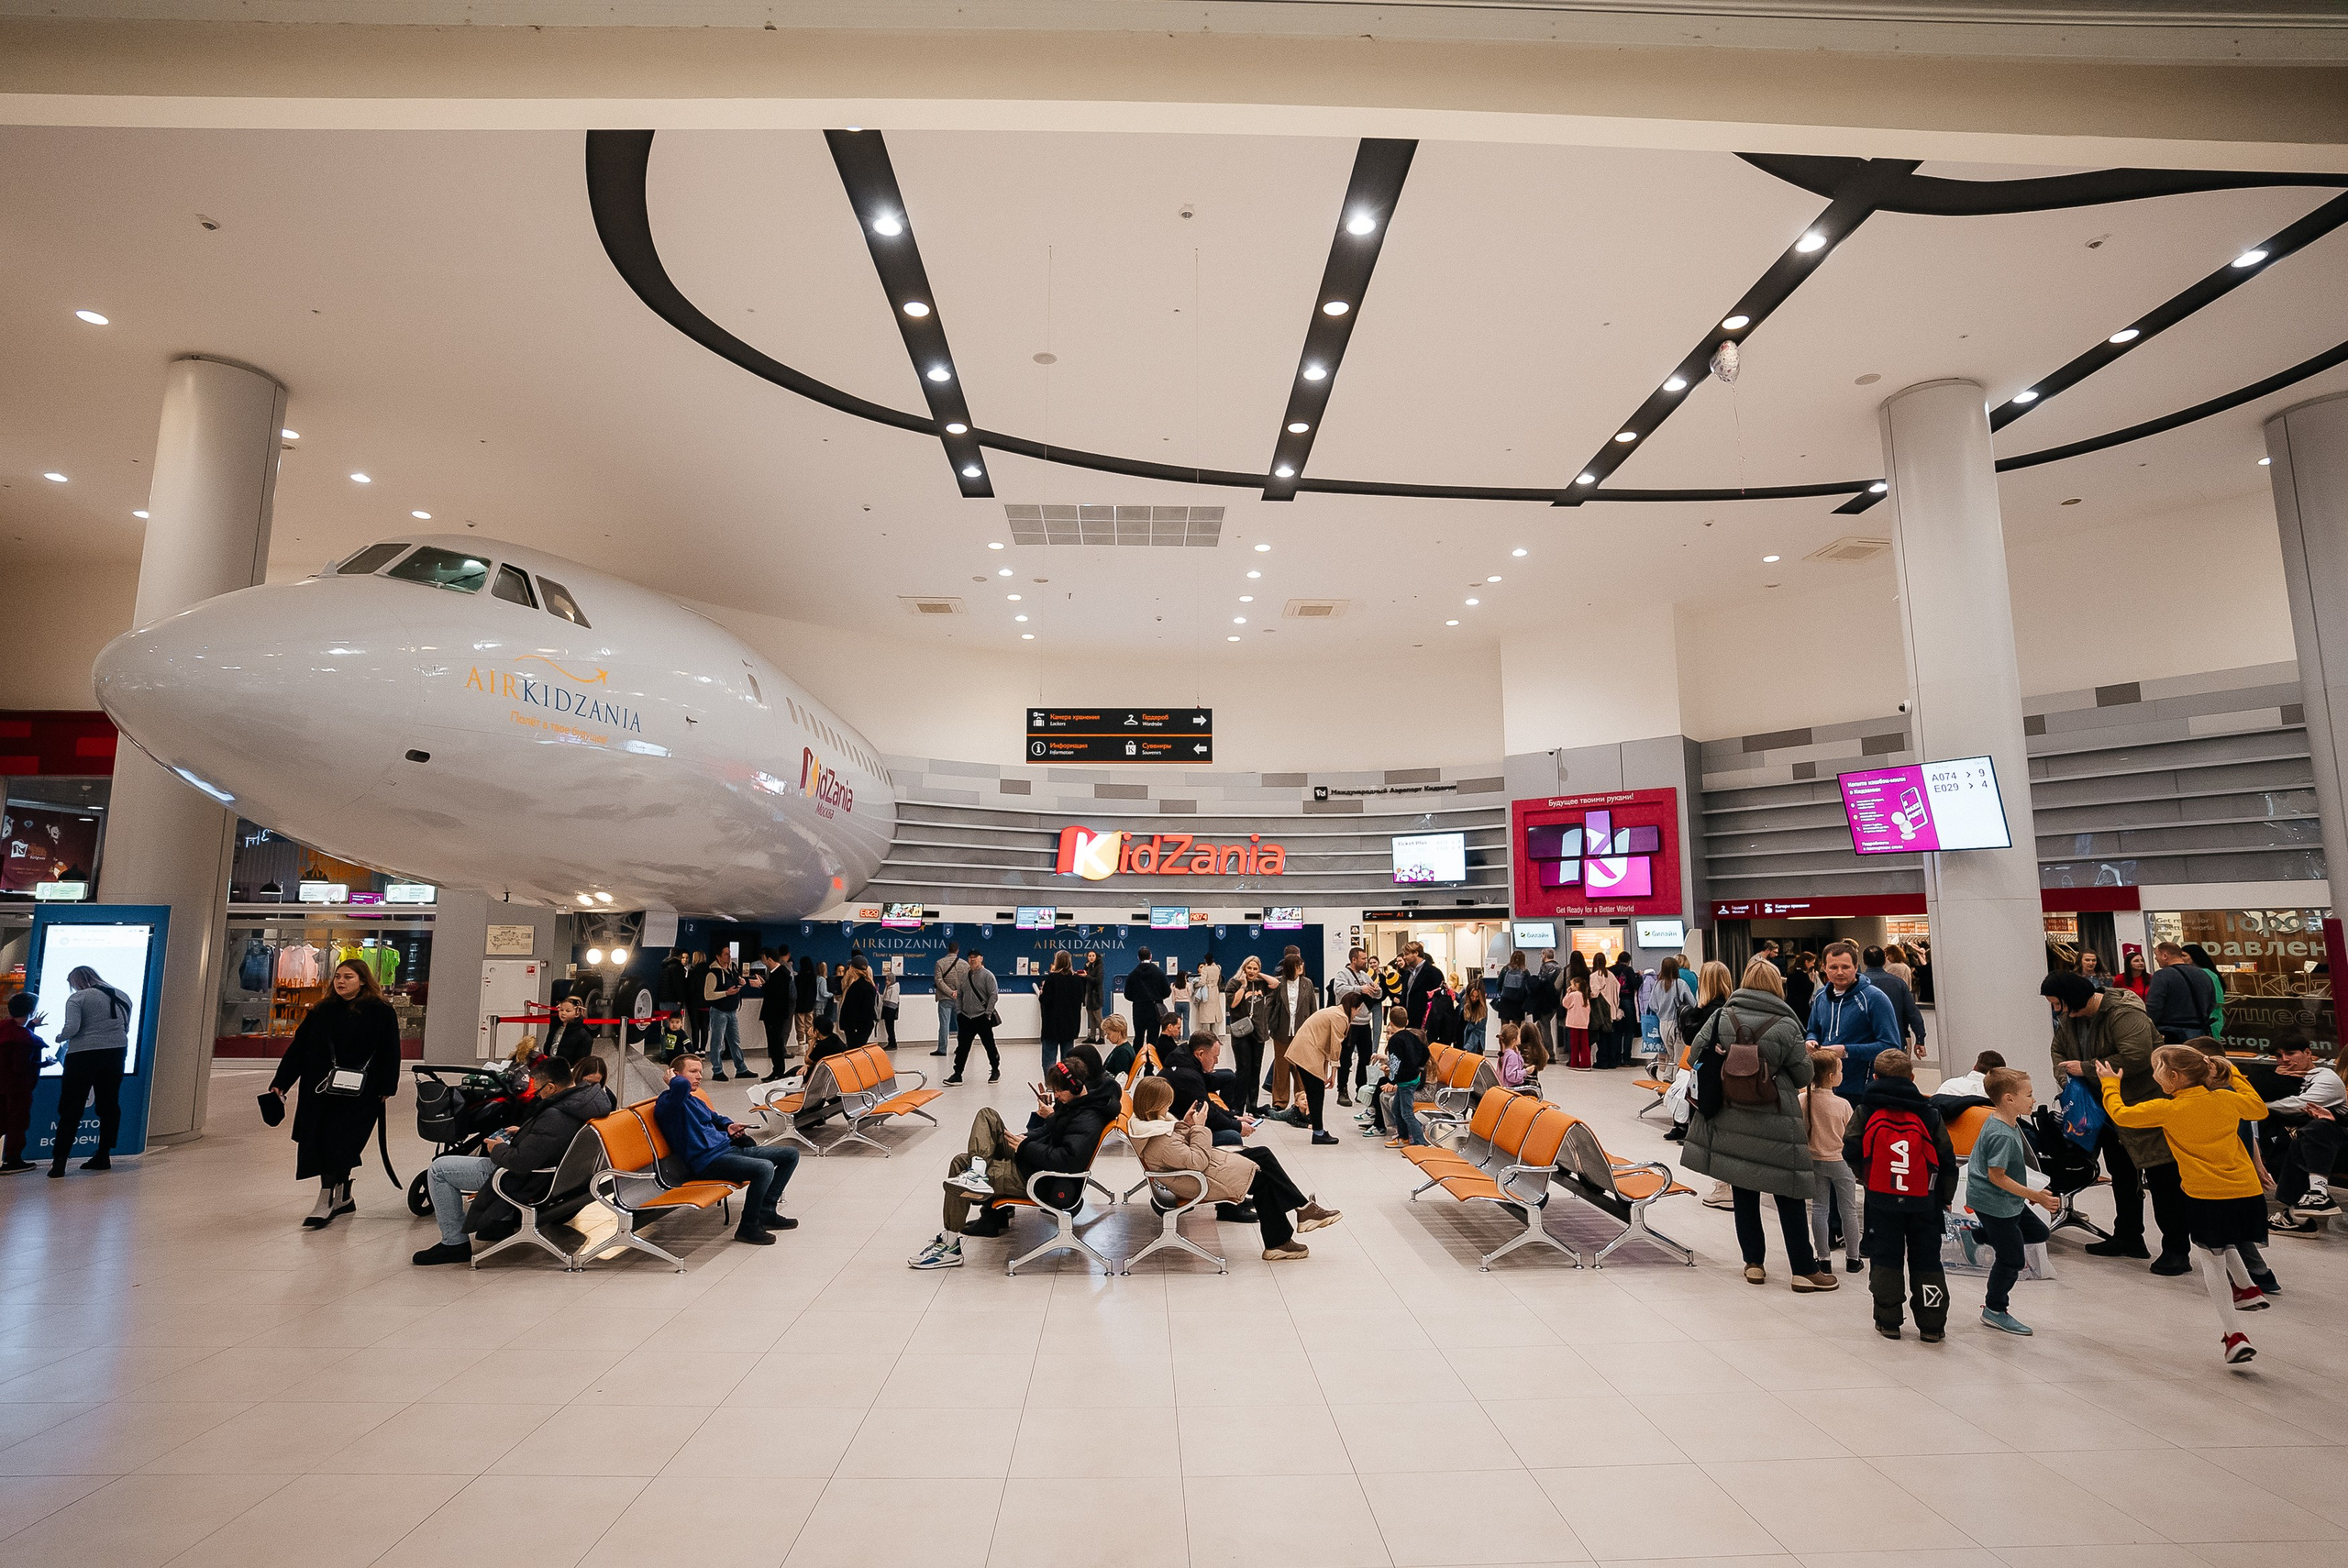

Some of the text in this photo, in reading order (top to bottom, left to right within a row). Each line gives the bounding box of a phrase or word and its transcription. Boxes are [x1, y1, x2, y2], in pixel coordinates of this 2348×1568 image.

[465, 666, 642, 733] AIRKIDZANIA
[1050, 713, 1071, 722] Камера
[800, 746, 854, 813] KidZania
[1932, 768, 1986, 781] A074 9
[1933, 782, 1959, 793] E029
[1548, 797, 1578, 809] Будущее
[1606, 792, 1634, 803] руками!
[1057, 825, 1286, 880] KidZania
[1556, 906, 1566, 914] Get
[1567, 906, 1583, 915] Ready
[1584, 905, 1593, 913] for
[1599, 905, 1615, 913] Better
[1616, 904, 1634, 913] World
[689, 923, 693, 932] 2
[804, 925, 810, 933] 3
[852, 938, 947, 948] AIRKIDZANIA
[1034, 939, 1125, 949] AIRKIDZANIA
[1889, 1140, 1910, 1191] FILA
